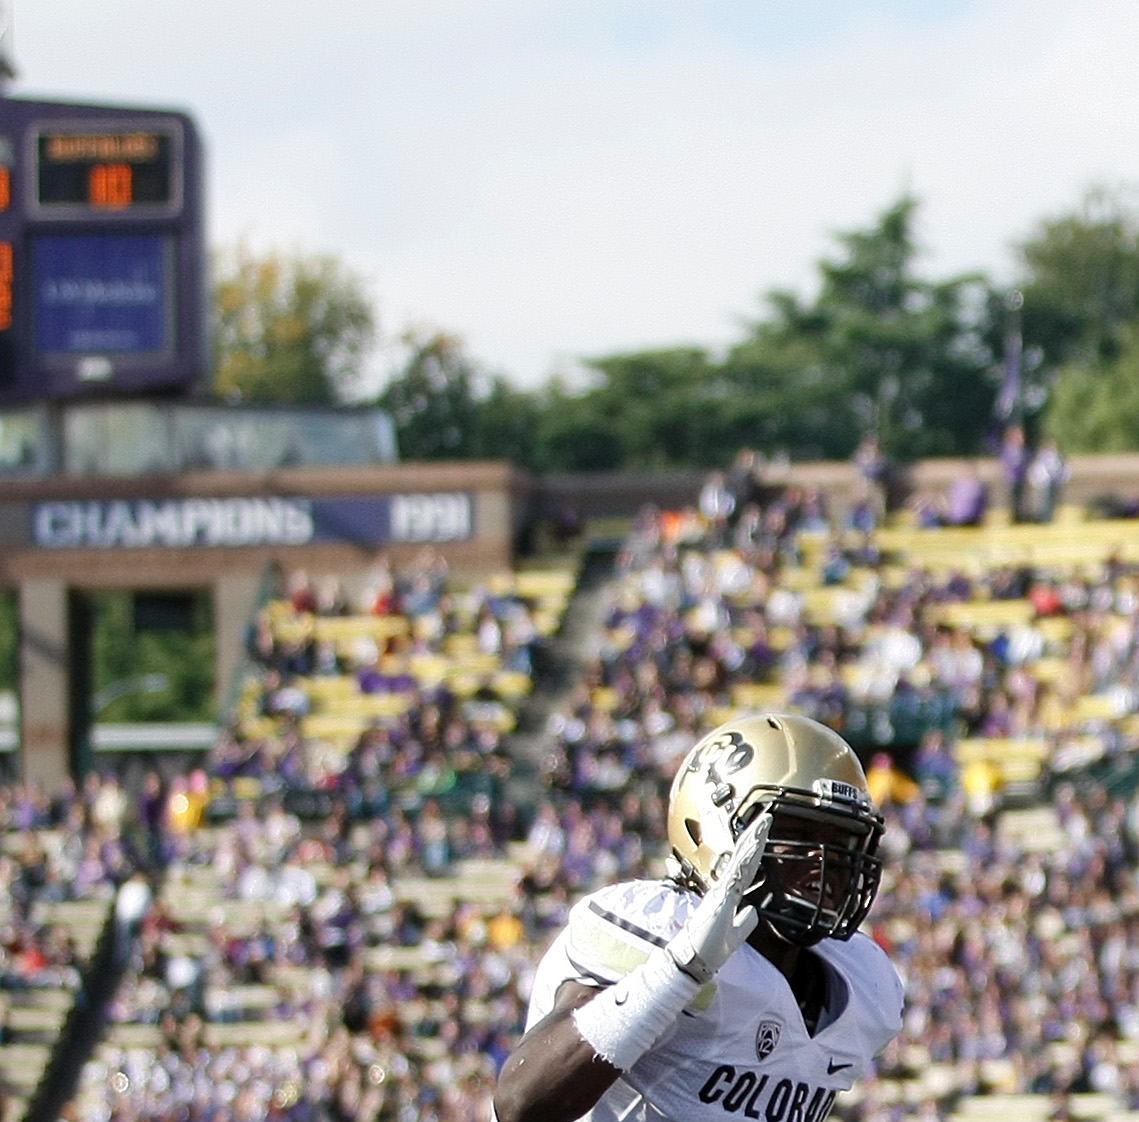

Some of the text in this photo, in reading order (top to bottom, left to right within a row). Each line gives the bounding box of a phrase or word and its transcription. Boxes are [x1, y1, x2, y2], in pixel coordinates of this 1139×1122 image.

[36, 494, 473, 548] CHAMPIONS 1991
[832, 782, 857, 799] BUFFS
